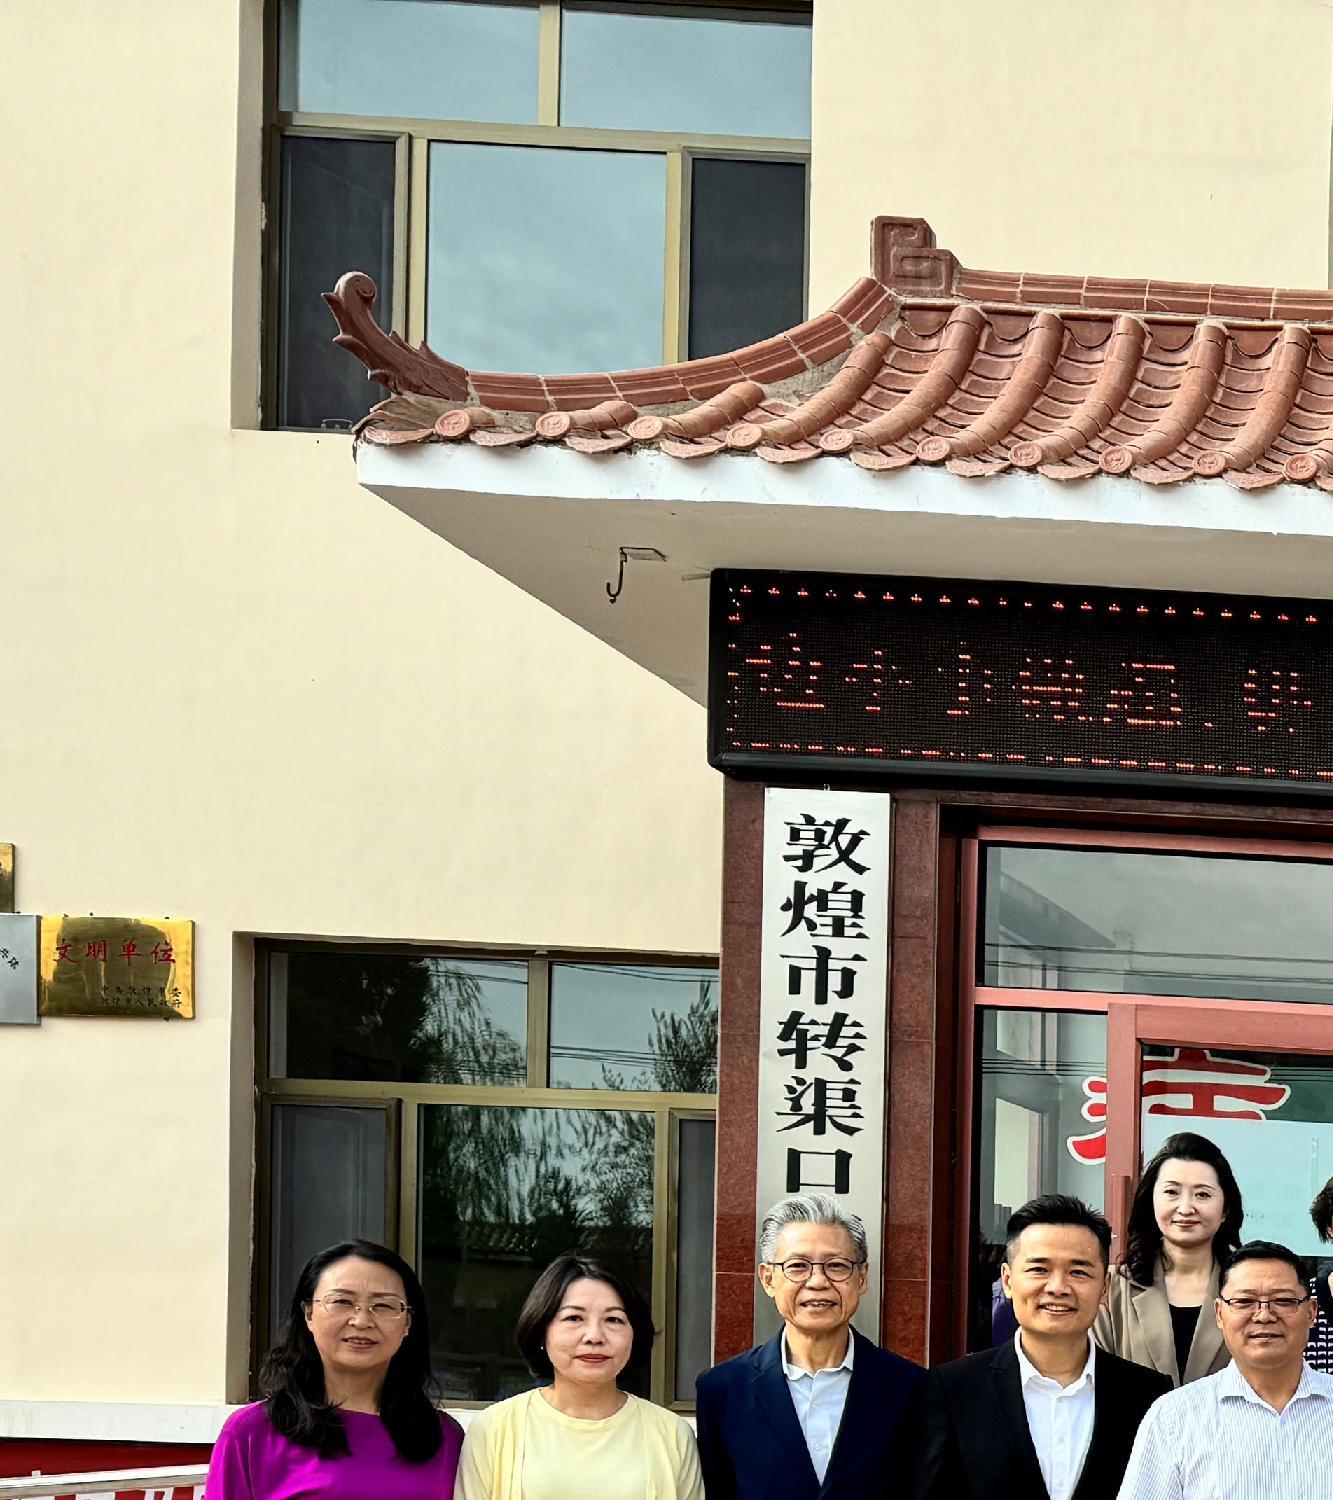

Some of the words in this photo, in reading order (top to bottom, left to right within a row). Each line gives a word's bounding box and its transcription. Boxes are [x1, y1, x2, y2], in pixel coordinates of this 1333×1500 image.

[53, 939, 176, 967] 文明单位
[774, 813, 872, 1195] 敦煌市转渠口
